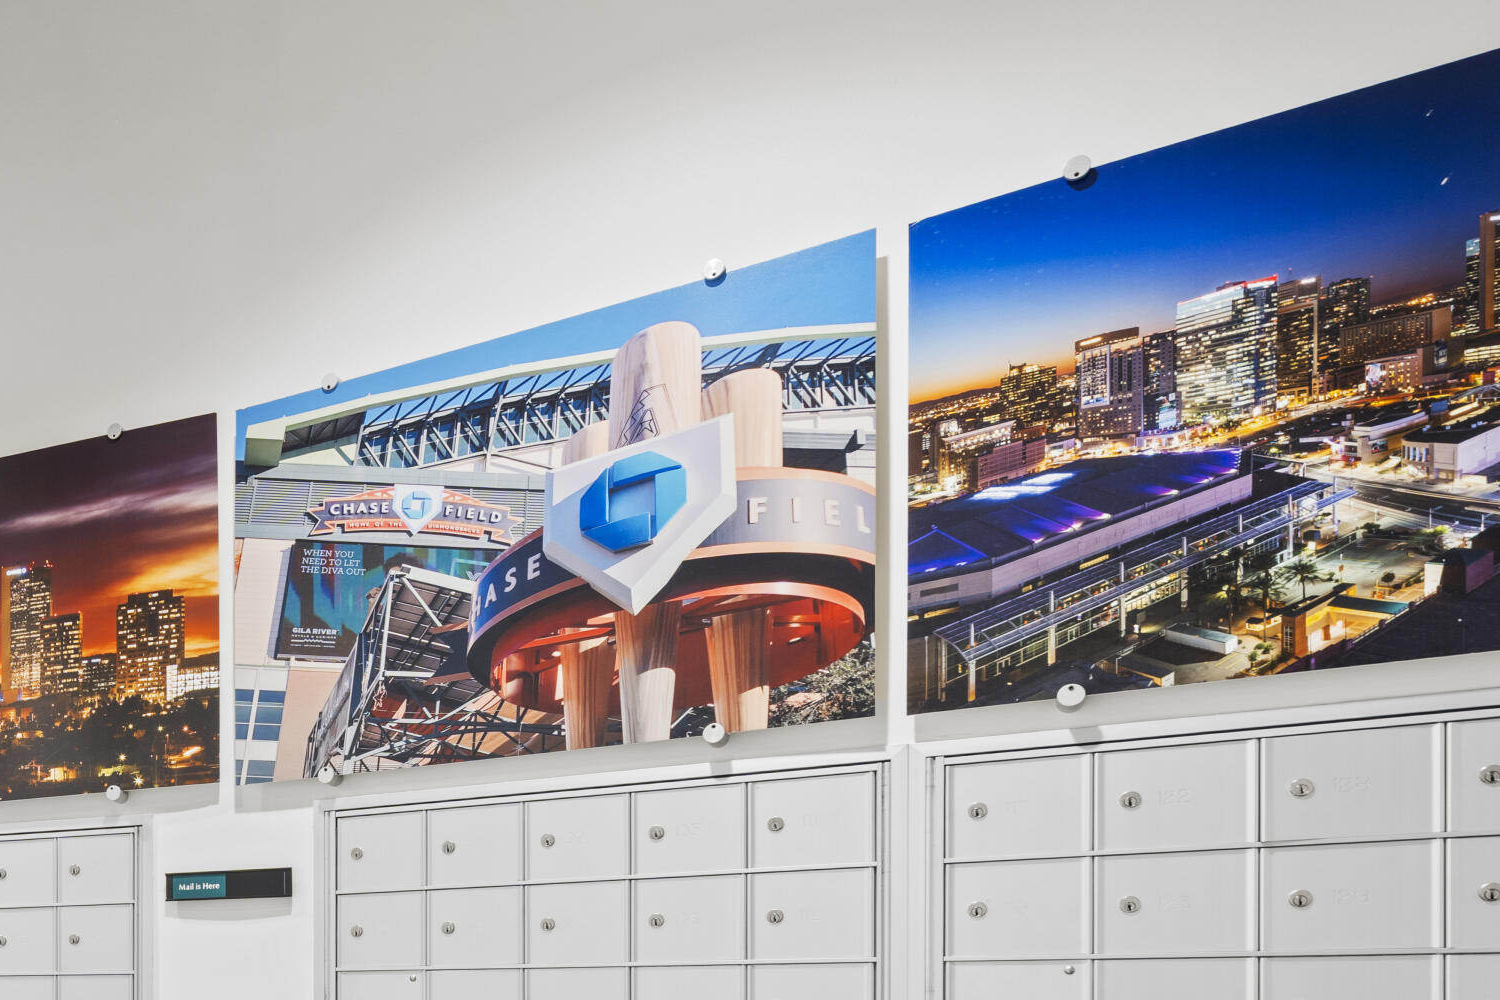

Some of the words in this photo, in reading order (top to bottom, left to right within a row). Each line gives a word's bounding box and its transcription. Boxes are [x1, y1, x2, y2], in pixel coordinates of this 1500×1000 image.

[329, 502, 389, 516] CHASE
[445, 505, 503, 523] FIELD
[303, 548, 333, 557] WHEN
[335, 550, 355, 558] YOU
[301, 557, 327, 566] NEED
[328, 558, 342, 566] TO
[344, 559, 361, 567] LET
[301, 565, 320, 574] THE
[321, 566, 344, 575] DIVA
[346, 567, 367, 576] OUT
[468, 552, 541, 632] HASE
[179, 882, 195, 891] Mail
[195, 882, 202, 890] is
[202, 882, 220, 890] Here
